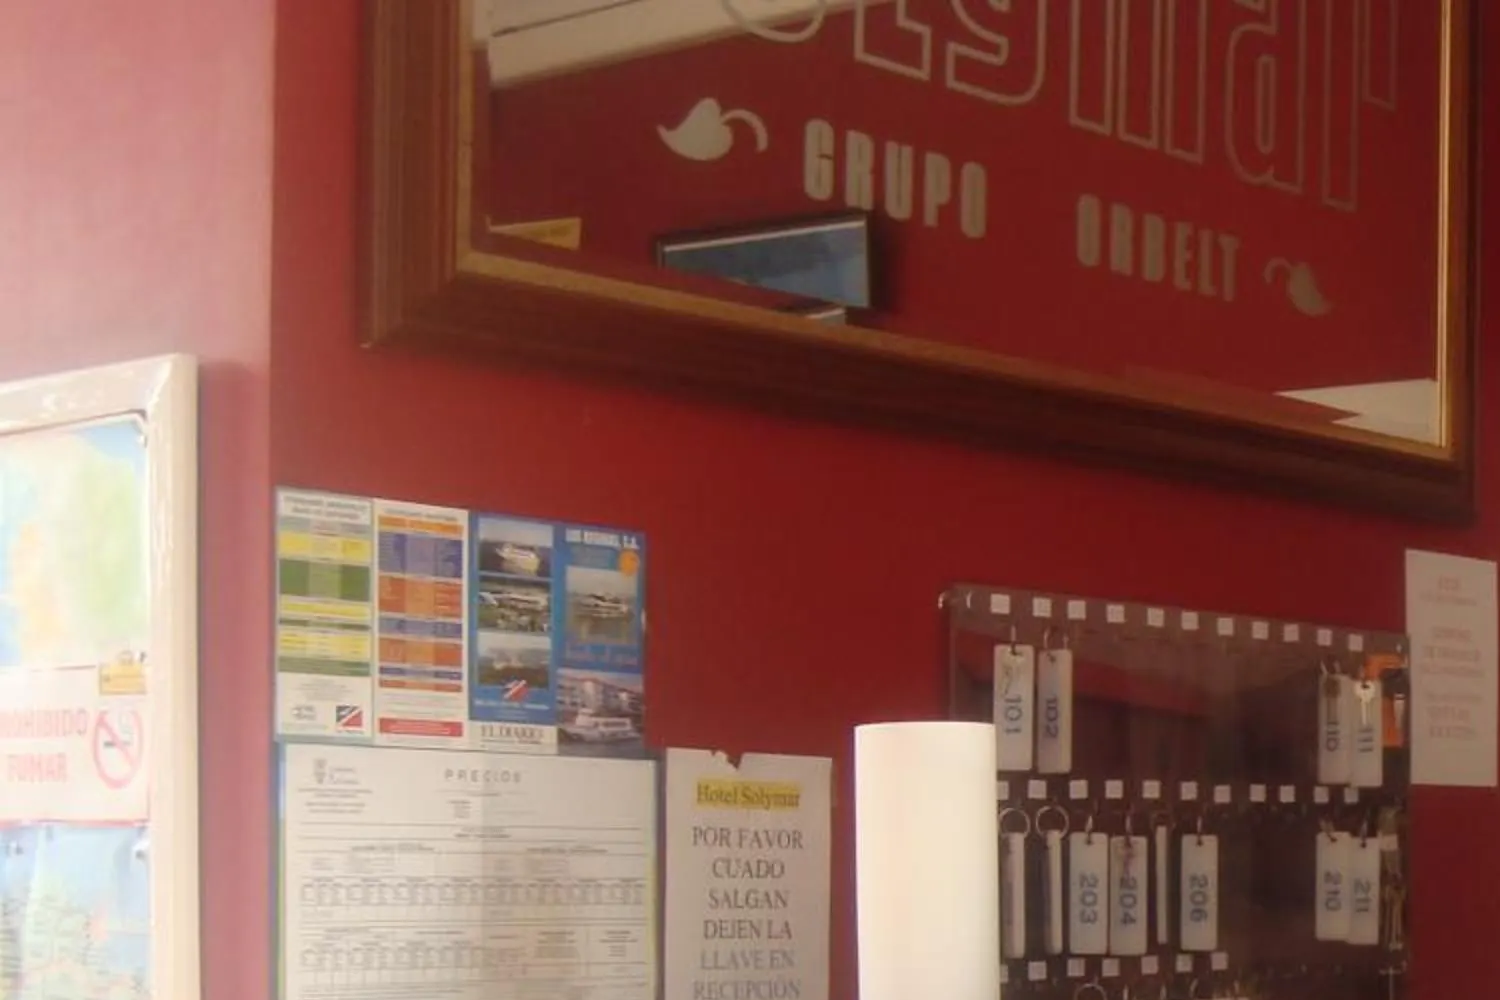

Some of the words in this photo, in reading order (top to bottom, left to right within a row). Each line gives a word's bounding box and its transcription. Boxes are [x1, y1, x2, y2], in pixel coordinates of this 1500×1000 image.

[804, 118, 988, 240] GRUPO
[1003, 694, 1024, 736] 101
[1045, 694, 1060, 739] 102
[444, 767, 523, 784] PRECIOS
[697, 783, 738, 804] Hotel
[741, 784, 801, 811] Solymar
[692, 825, 732, 848] POR
[737, 826, 804, 849] FAVOR
[712, 856, 785, 879] CUADO
[708, 888, 790, 909] SALGAN
[1079, 873, 1099, 925] 203
[1120, 876, 1137, 926] 204
[1189, 873, 1209, 922] 206
[703, 919, 761, 941] DEJEN
[766, 919, 793, 940] LA
[699, 951, 764, 971] LLAVE
[769, 951, 795, 970] EN
